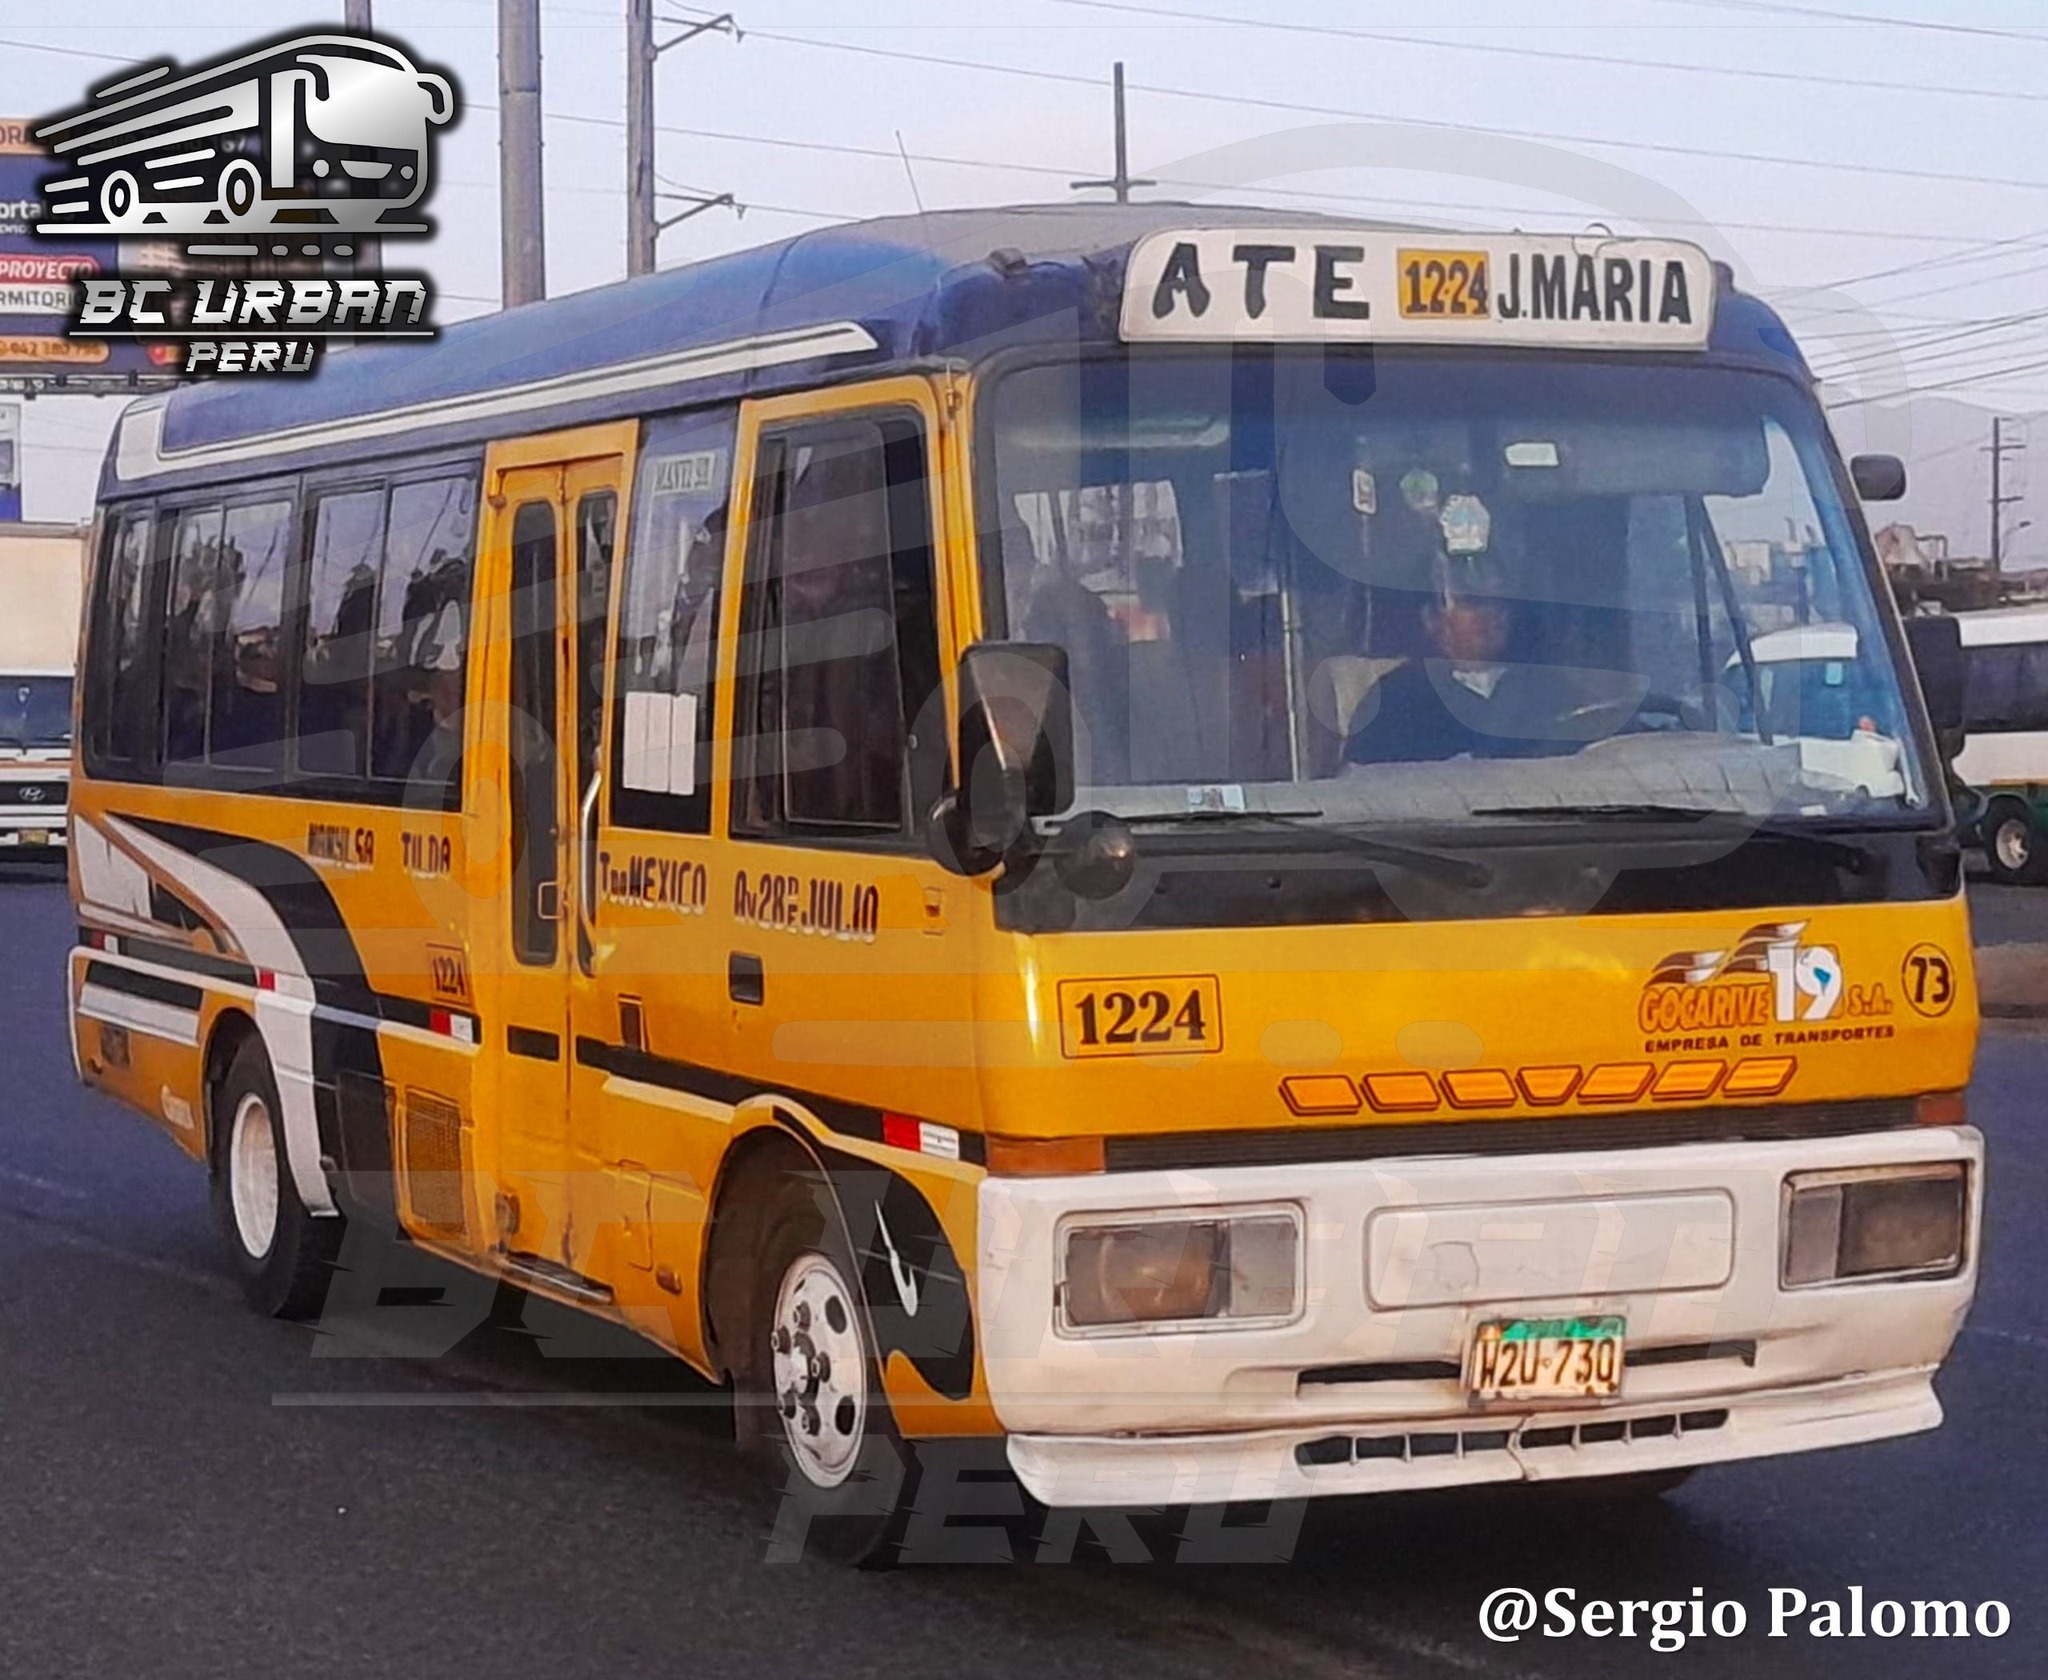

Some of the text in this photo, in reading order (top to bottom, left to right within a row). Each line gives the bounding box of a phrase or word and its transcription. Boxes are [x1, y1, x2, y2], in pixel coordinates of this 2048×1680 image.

[1151, 243, 1692, 324] ATE 1224 J.MARIA
[1767, 940, 1844, 1023] 19
[1909, 956, 1951, 1003] 73
[1075, 989, 1206, 1045] 1224
[1645, 1024, 1895, 1053] EMPRESA DE TRANSPORTES
